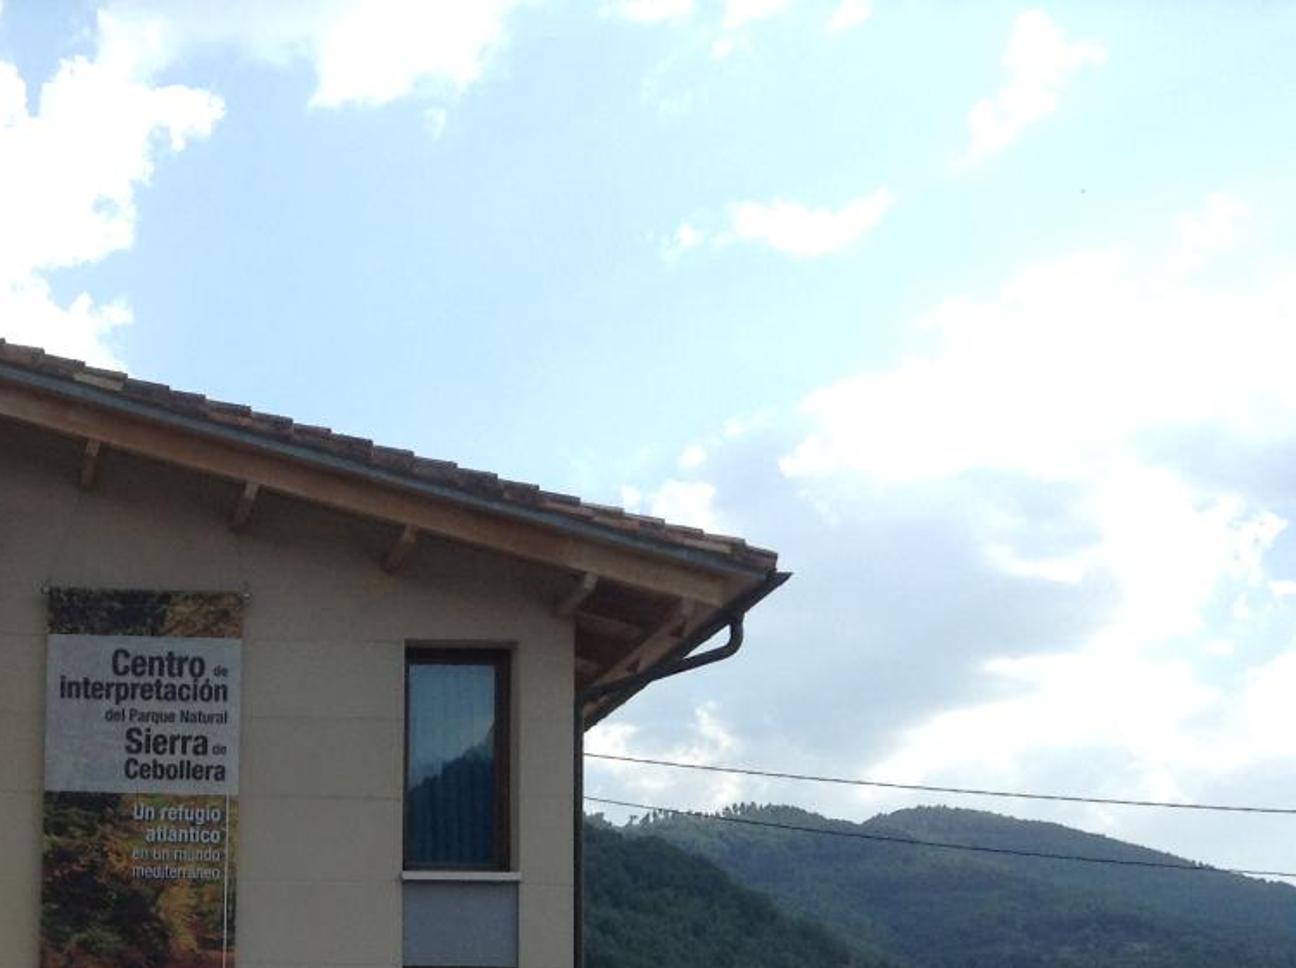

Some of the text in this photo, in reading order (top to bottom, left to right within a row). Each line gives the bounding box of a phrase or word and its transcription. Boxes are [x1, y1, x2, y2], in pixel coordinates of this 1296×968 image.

[112, 648, 228, 678] Centro de
[60, 675, 228, 705] interpretación
[105, 708, 227, 725] del Parque Natural
[125, 727, 227, 756] Sierra de
[124, 757, 226, 781] Cebollera
[133, 802, 221, 824] Un refugio
